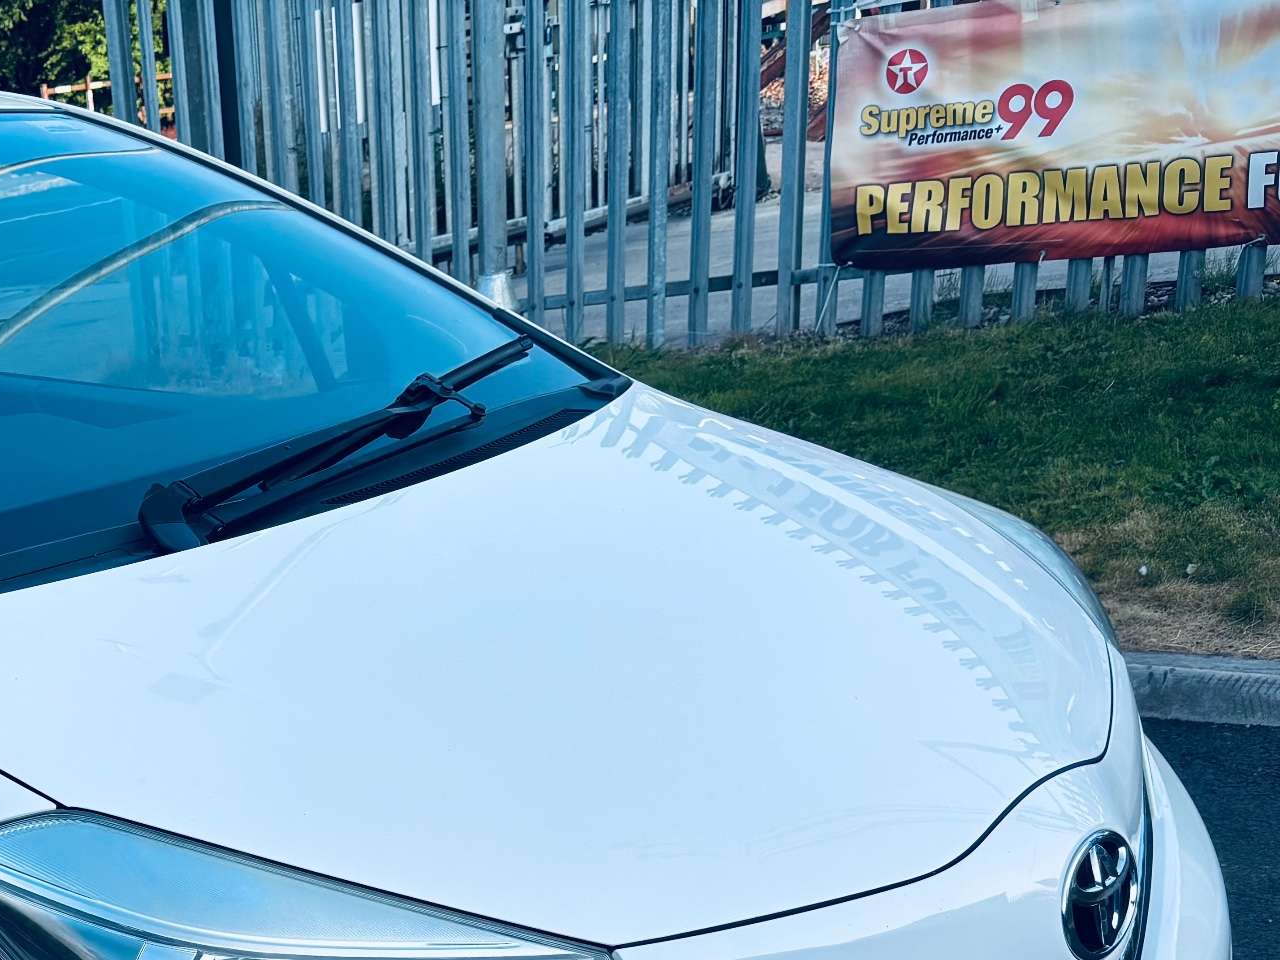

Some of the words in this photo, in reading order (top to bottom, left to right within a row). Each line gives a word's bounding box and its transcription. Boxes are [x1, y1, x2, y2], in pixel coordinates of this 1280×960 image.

[860, 99, 994, 137] Supreme
[997, 79, 1074, 141] 99
[856, 155, 1233, 235] PERFORMANCE
[1247, 151, 1280, 209] F
